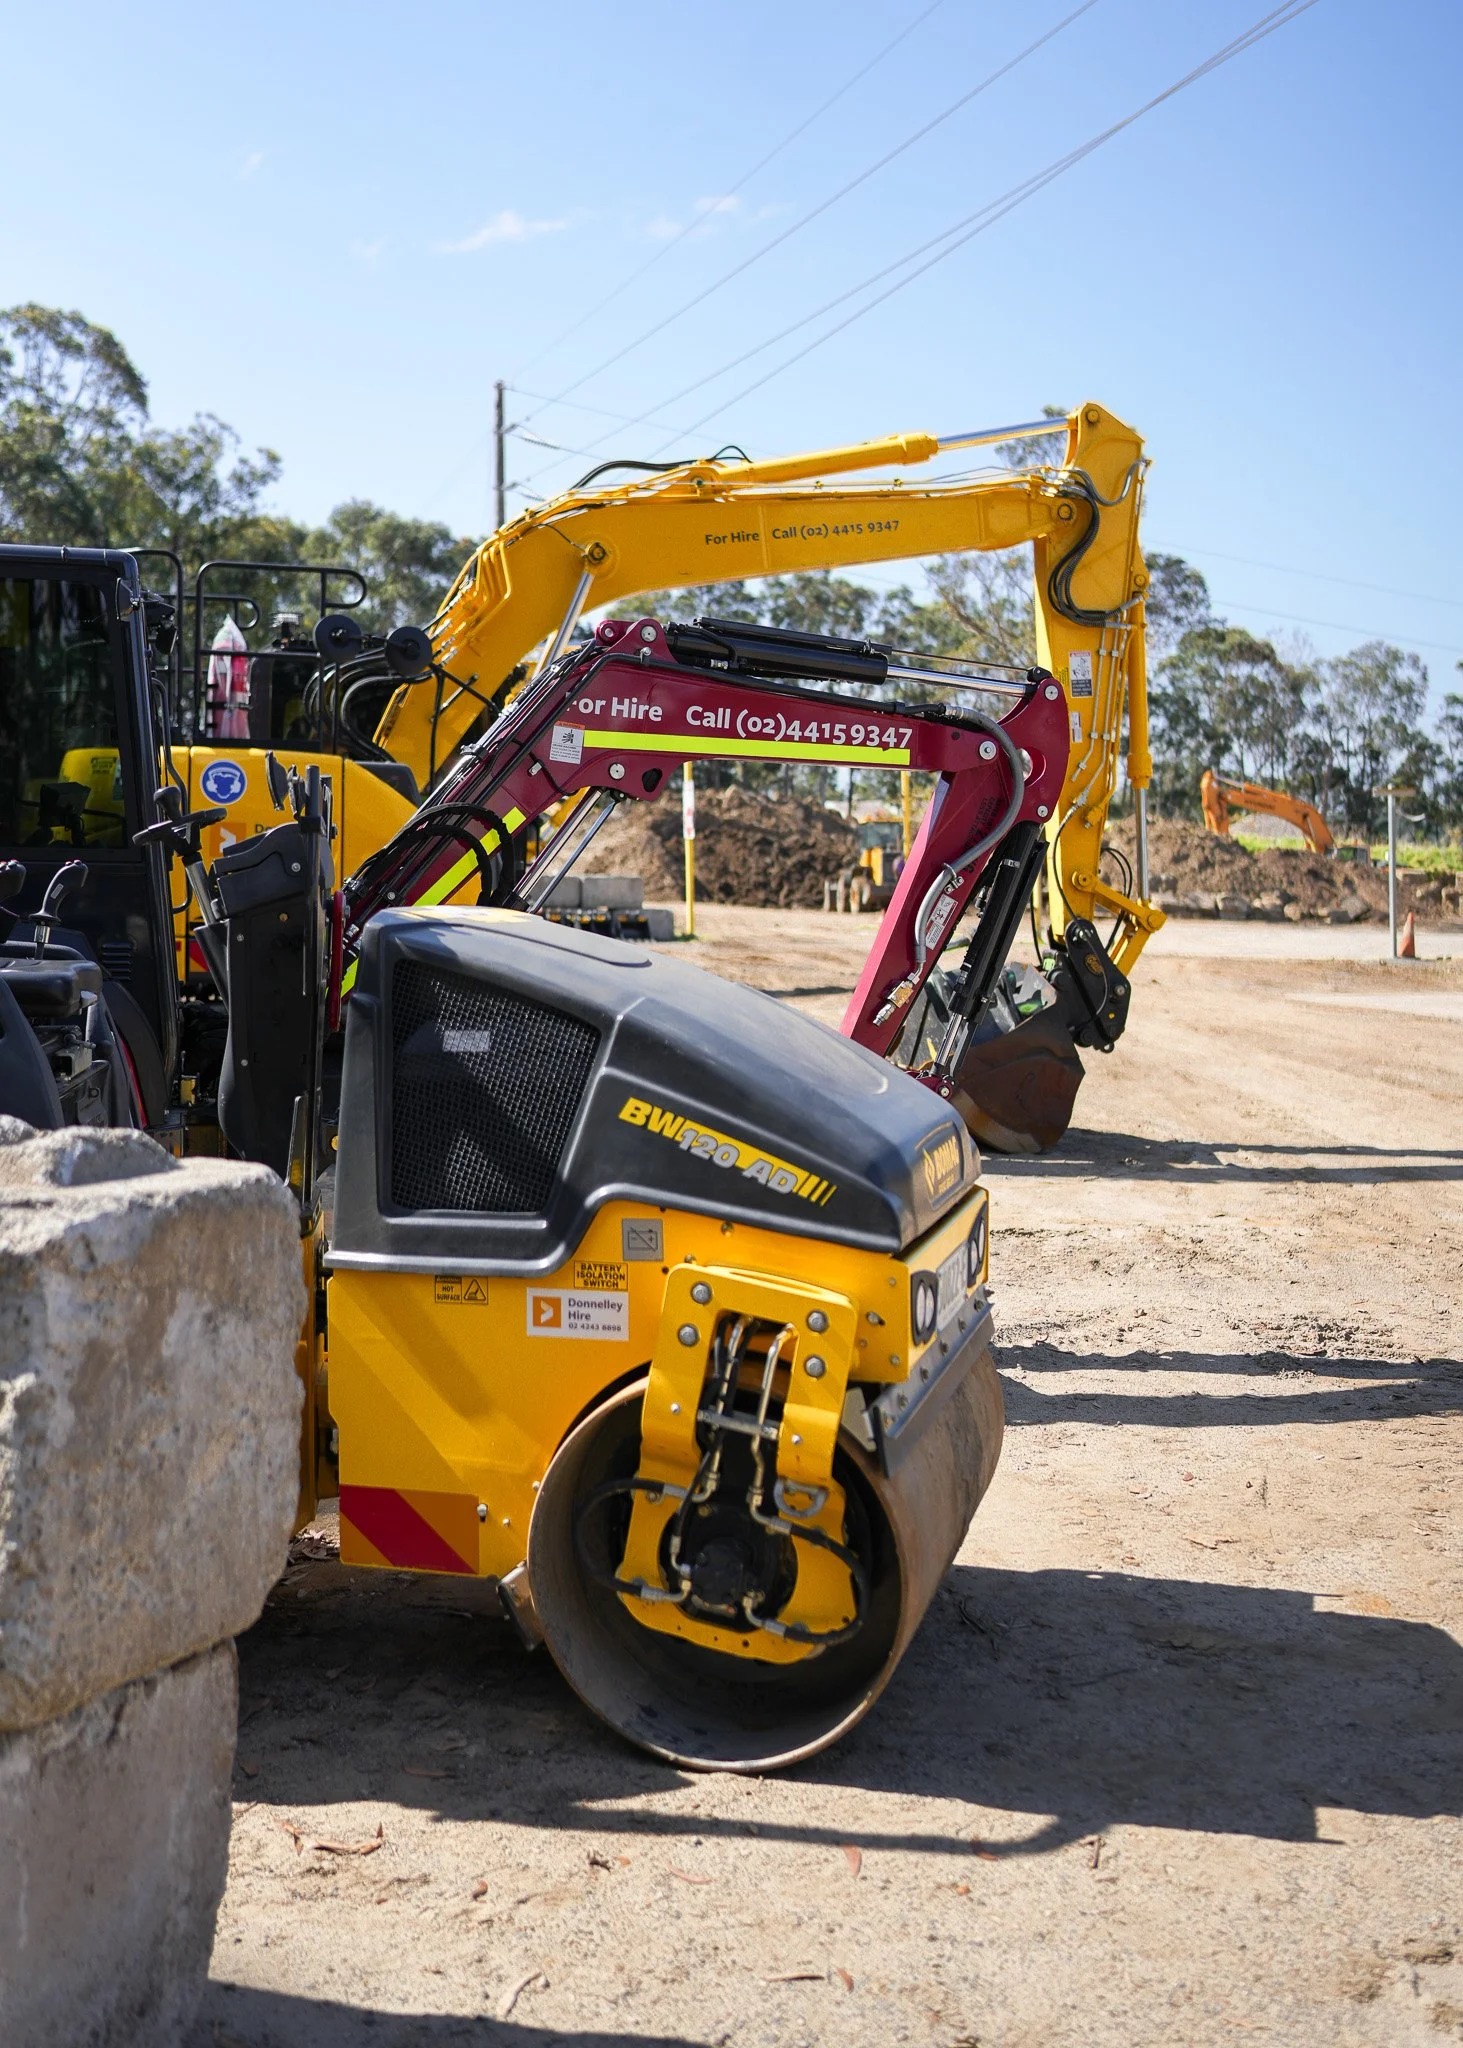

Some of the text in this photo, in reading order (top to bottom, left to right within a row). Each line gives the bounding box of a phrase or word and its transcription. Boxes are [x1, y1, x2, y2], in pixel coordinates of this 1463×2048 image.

[705, 520, 900, 545] For Hire Call (02) 4415 9347
[611, 696, 663, 722] Hire
[686, 705, 731, 729] Call
[742, 1158, 799, 1195] AD
[580, 1263, 621, 1272] BATTERY
[576, 1270, 626, 1281] ISOLATION
[583, 1279, 619, 1288] SWITCH
[568, 1298, 623, 1313] Donnelley
[568, 1311, 591, 1321] Hire
